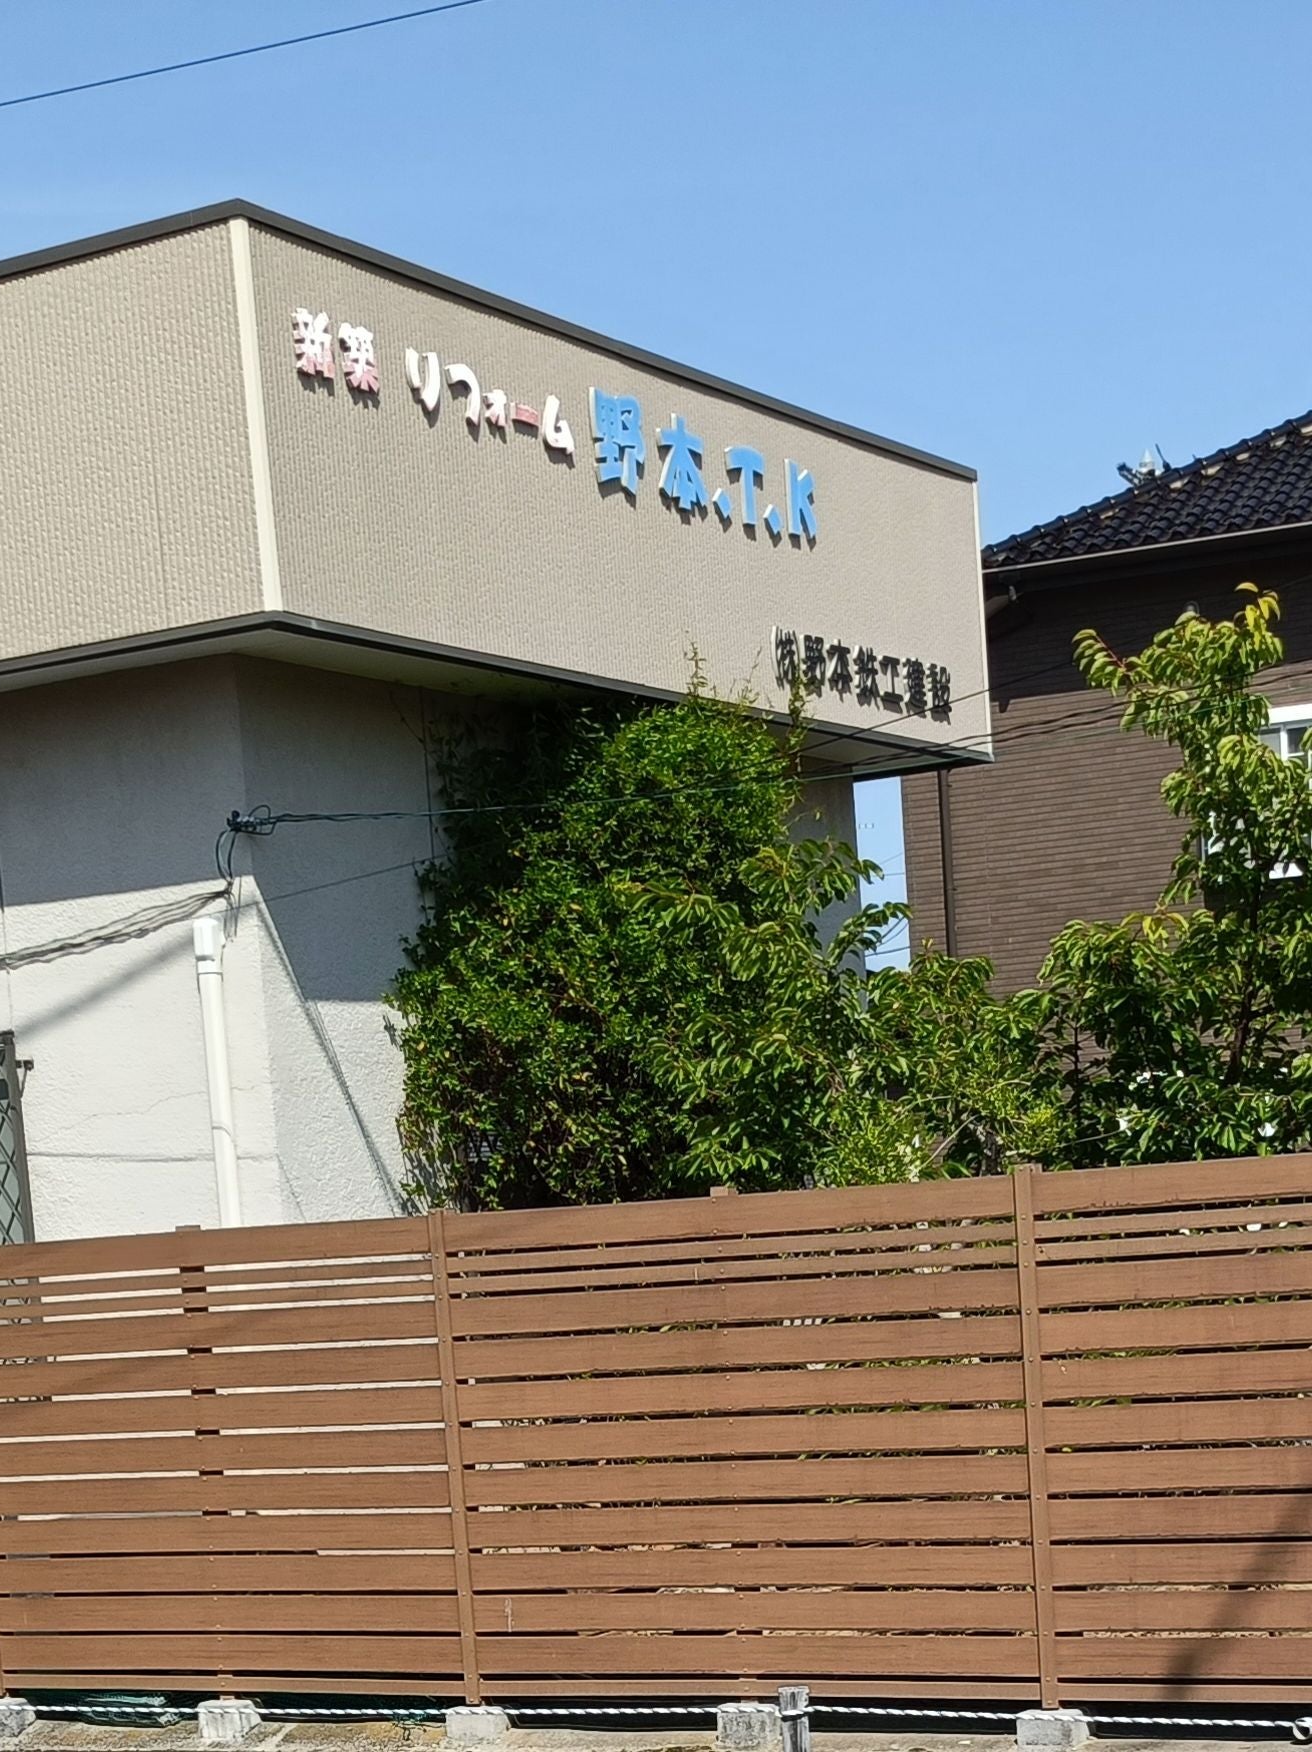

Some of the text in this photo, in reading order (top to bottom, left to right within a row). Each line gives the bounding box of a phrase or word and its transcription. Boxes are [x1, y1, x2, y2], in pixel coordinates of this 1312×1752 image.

[291, 308, 380, 392] 新築
[405, 347, 575, 454] リフォーム
